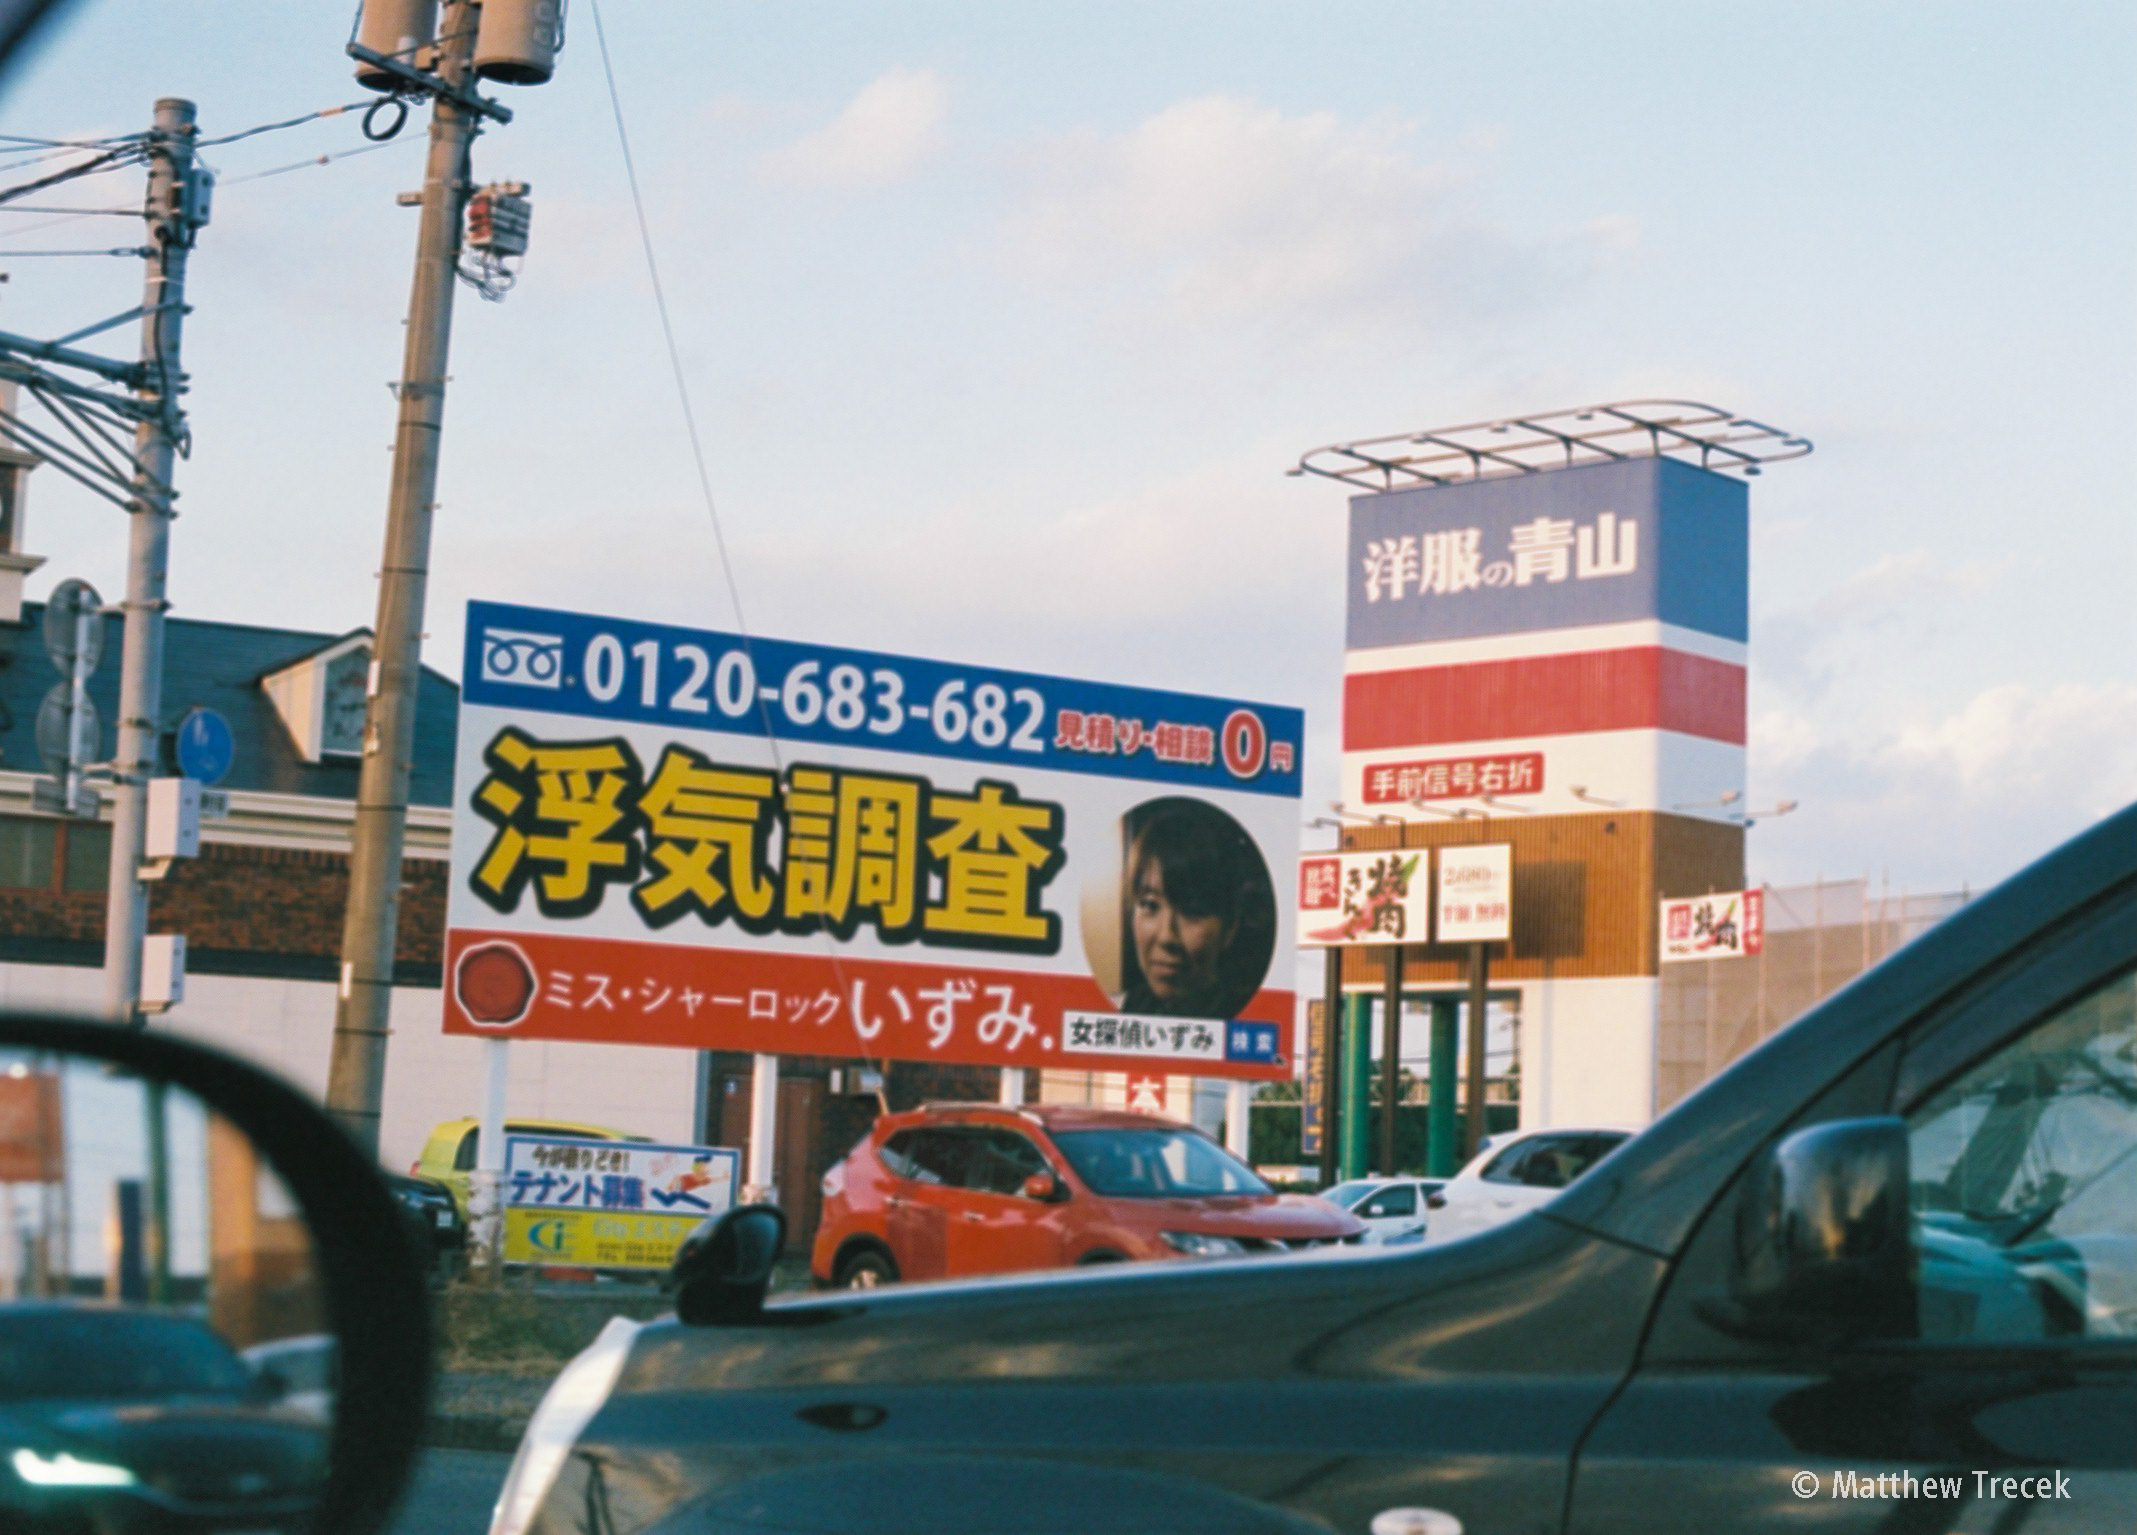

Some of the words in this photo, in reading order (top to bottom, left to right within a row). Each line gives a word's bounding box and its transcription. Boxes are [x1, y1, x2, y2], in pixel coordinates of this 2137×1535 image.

[1362, 512, 1638, 603] 洋服の青山
[583, 633, 1045, 752] 0120-683-682
[1372, 758, 1534, 799] 手前信号右折
[471, 727, 1064, 953] 浮気調査
[1070, 1016, 1215, 1051] 女探偵いずみ
